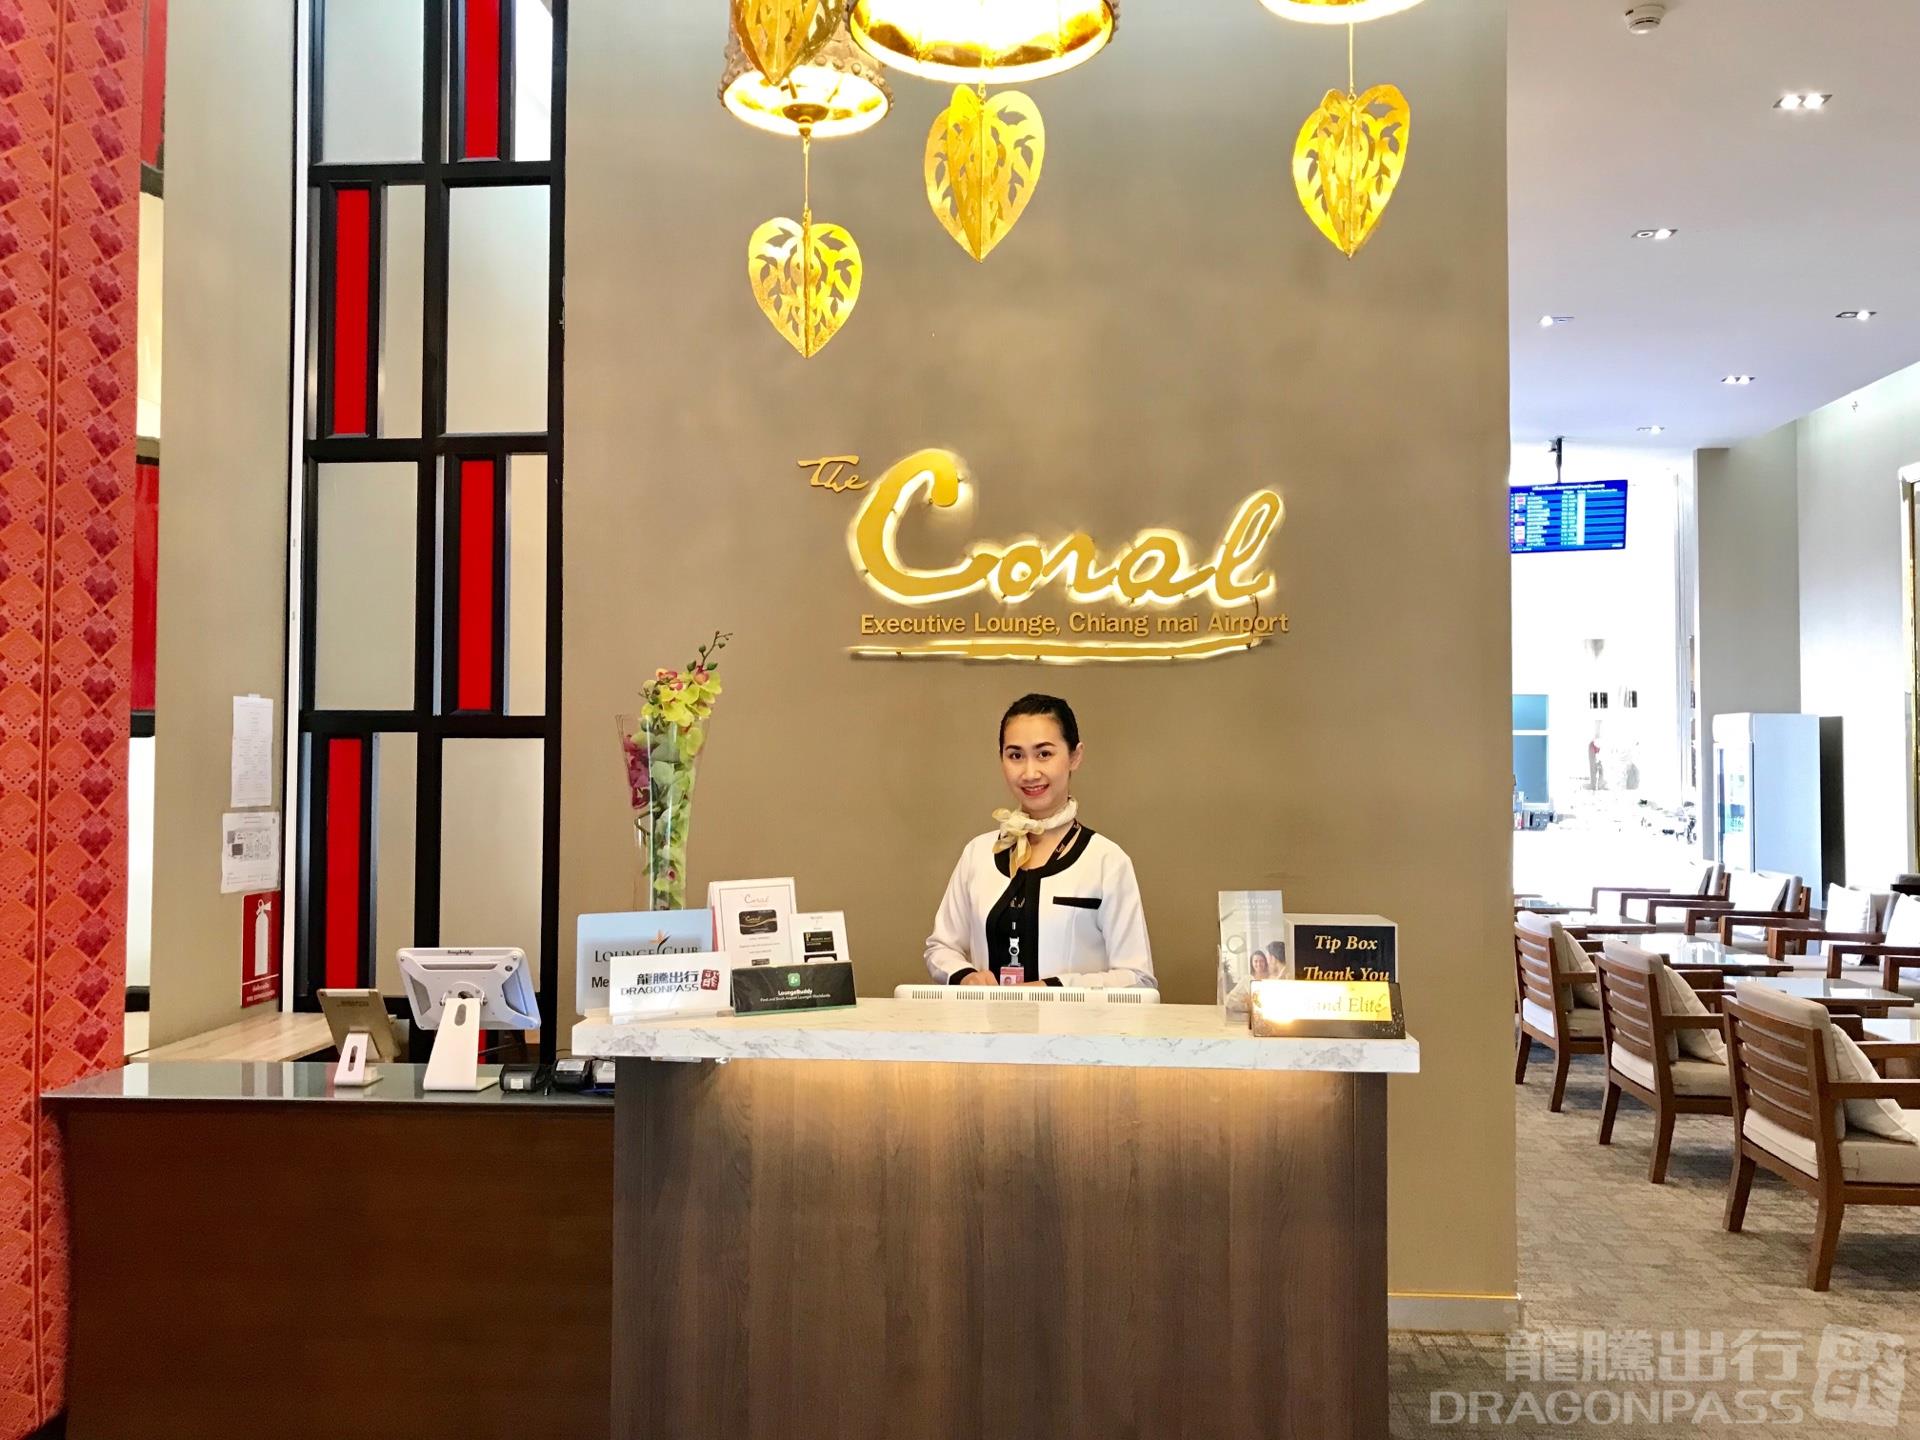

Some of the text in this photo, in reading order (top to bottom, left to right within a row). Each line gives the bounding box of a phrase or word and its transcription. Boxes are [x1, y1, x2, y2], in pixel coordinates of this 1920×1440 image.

[797, 448, 1283, 602] The Coral
[861, 612, 1289, 637] Executive Lounge, Chiang mai Airport
[1314, 935, 1378, 953] Tip Box
[1303, 966, 1390, 981] Thank You
[621, 984, 699, 995] DRAGONPASS
